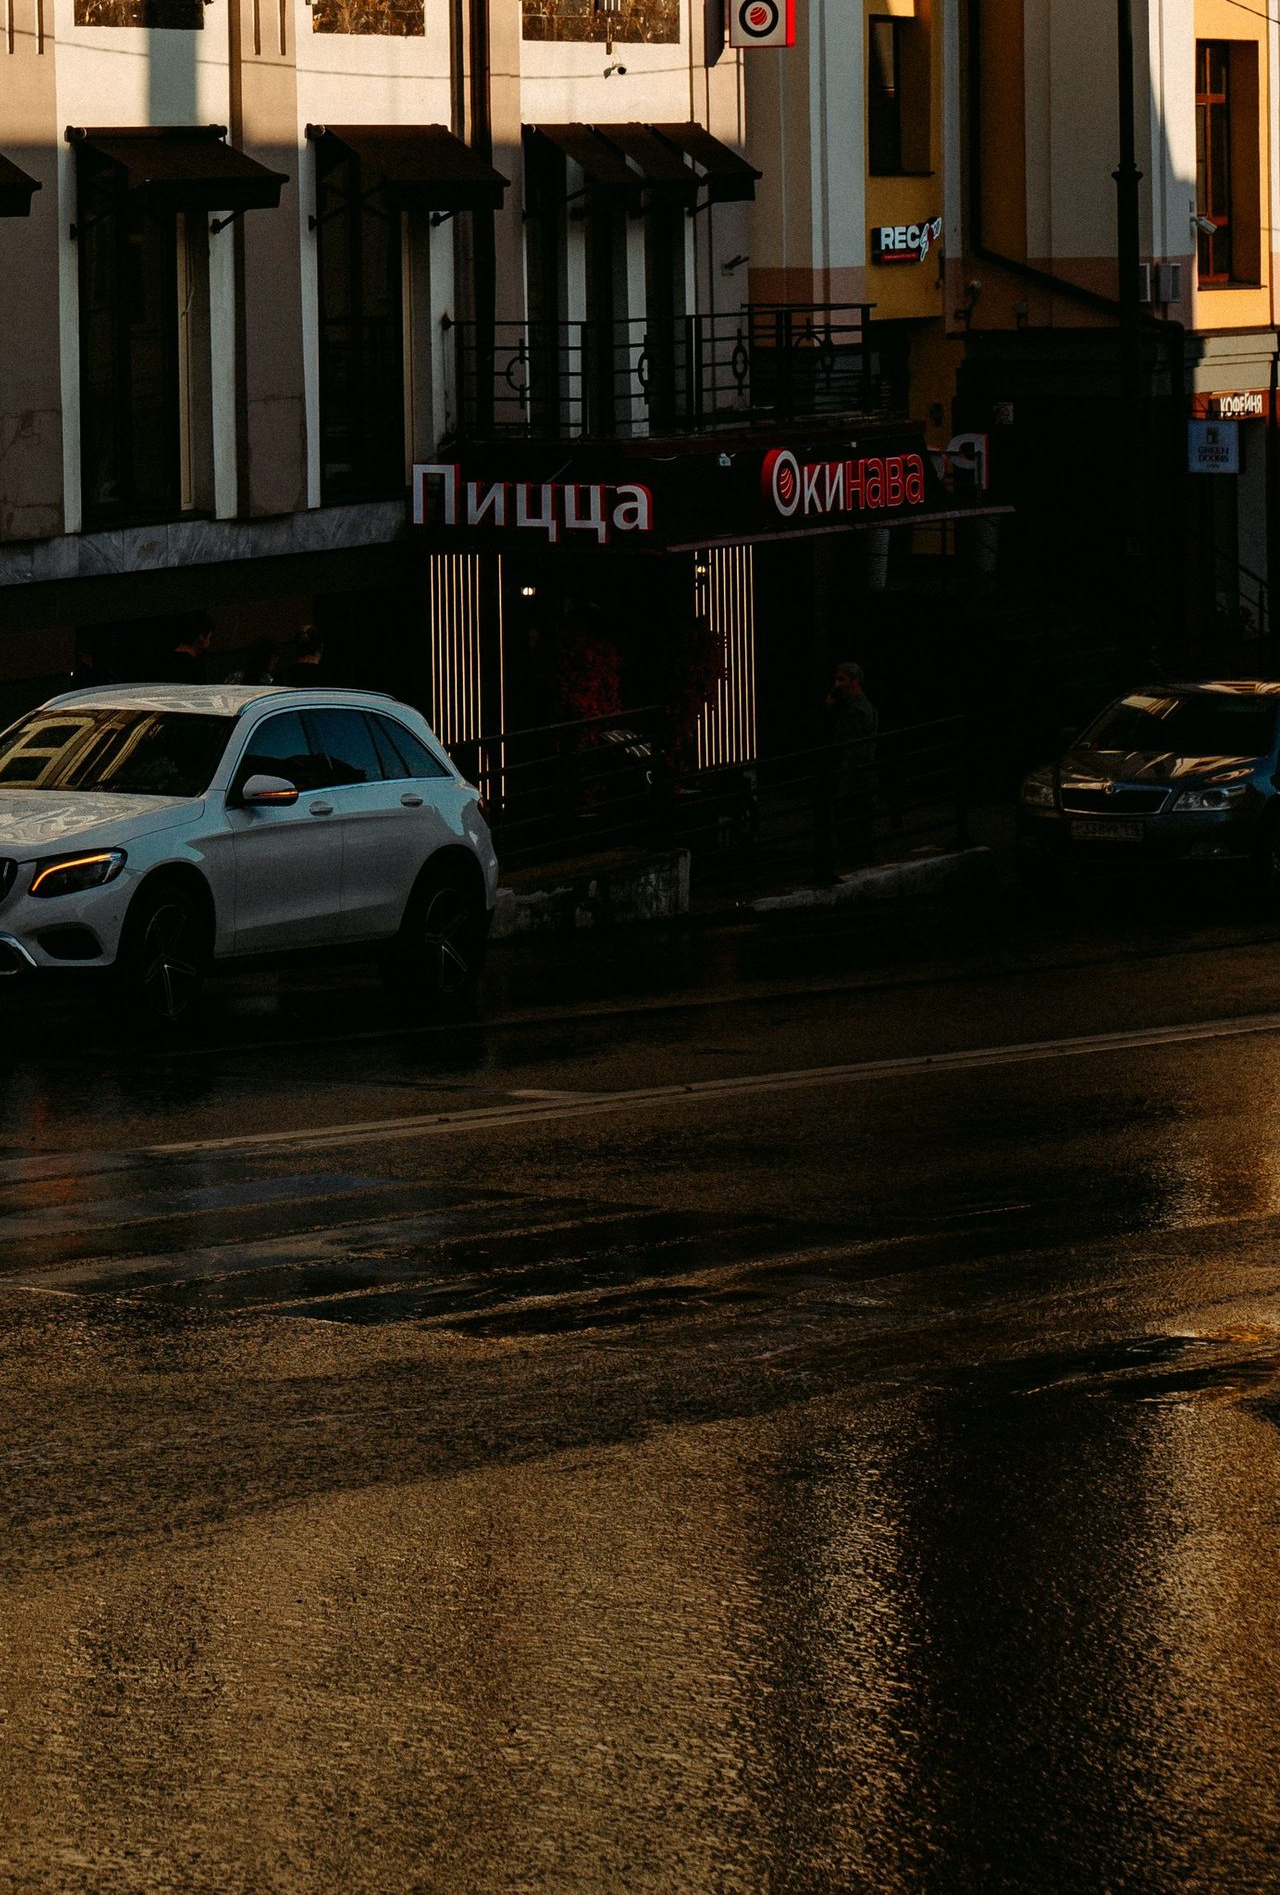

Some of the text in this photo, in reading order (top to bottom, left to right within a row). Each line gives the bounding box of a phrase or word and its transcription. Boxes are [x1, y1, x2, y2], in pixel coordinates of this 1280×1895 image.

[1220, 392, 1263, 417] КОФЕЙНЯ
[413, 463, 653, 544] Пицца
[772, 449, 925, 517] Окинава
